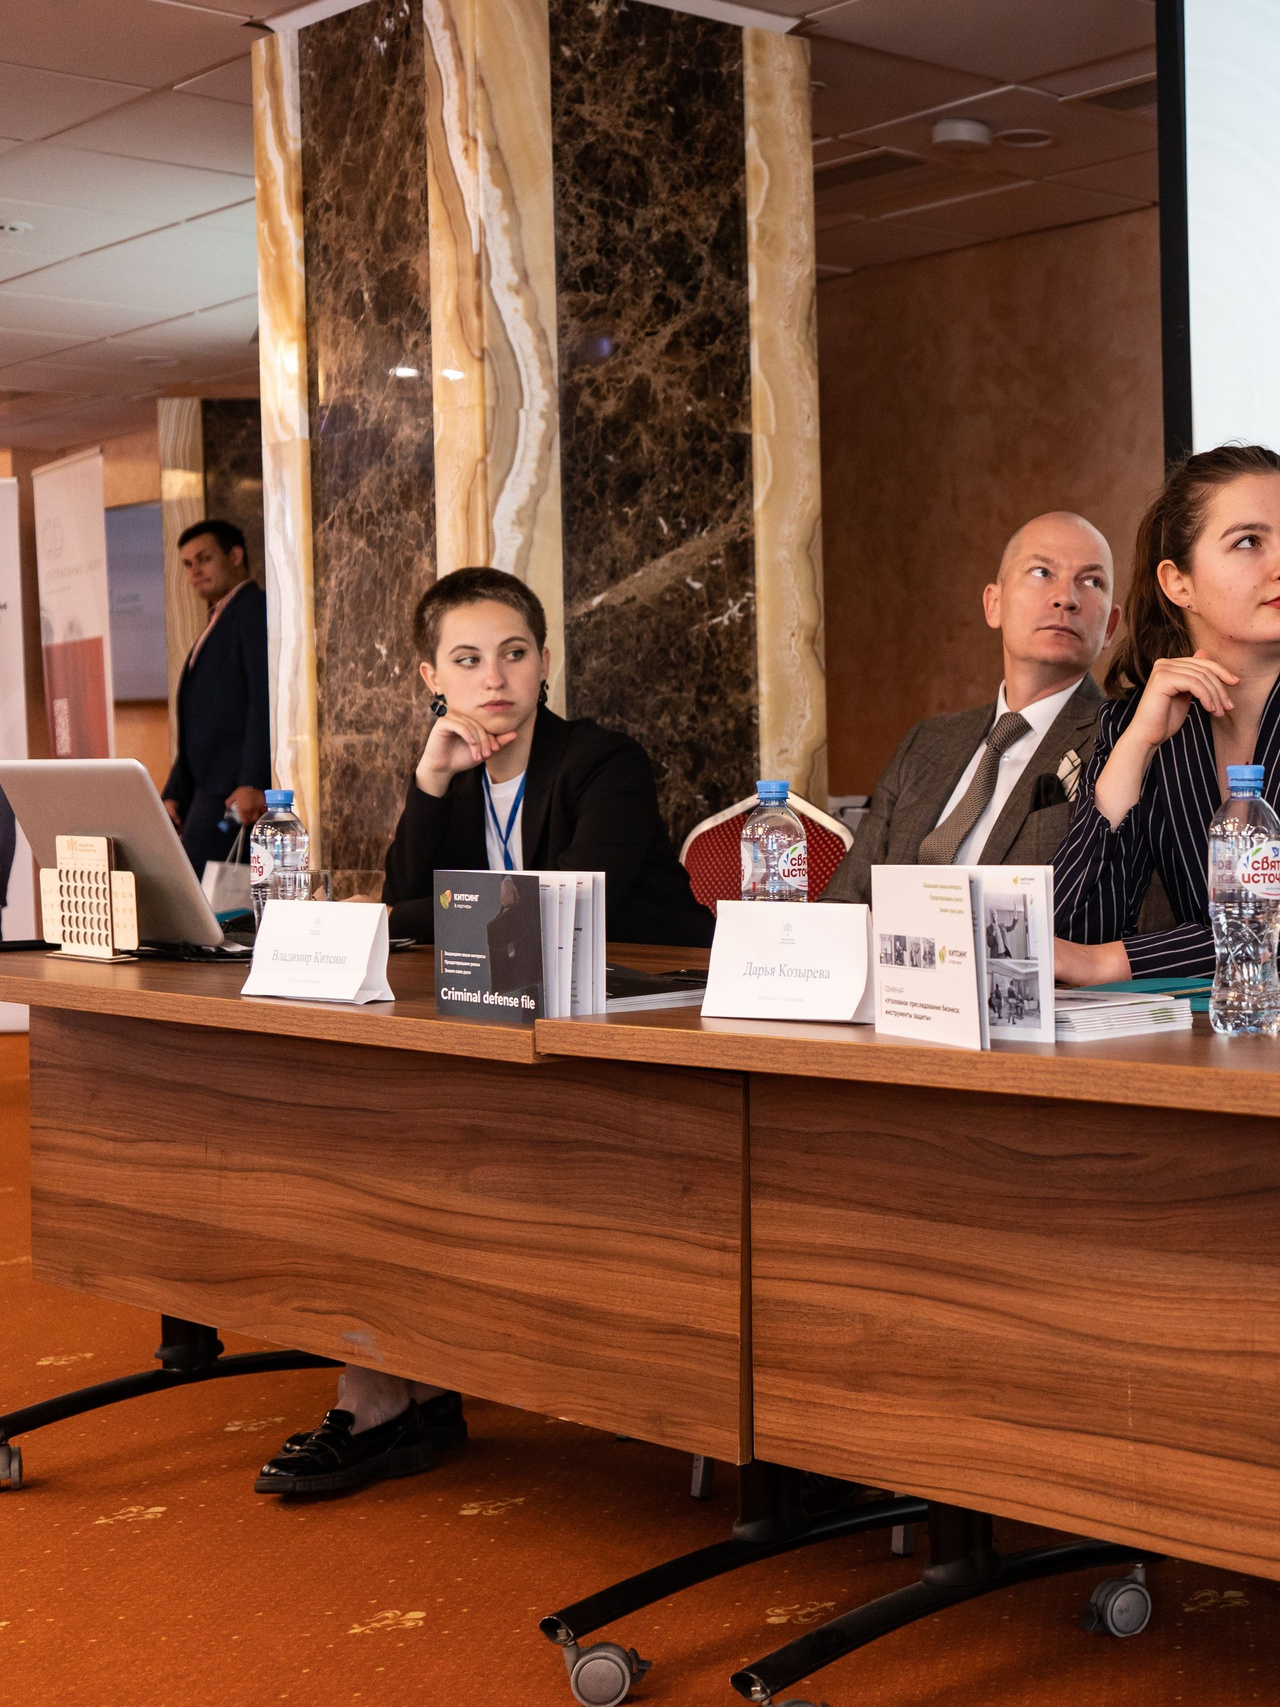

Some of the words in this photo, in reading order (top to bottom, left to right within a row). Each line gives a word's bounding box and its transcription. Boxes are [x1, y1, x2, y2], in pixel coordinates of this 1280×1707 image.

[272, 949, 312, 966] Владимир
[313, 951, 348, 965] Китсинг
[743, 961, 775, 979] Дарья
[778, 963, 831, 982] Козырева
[441, 987, 481, 1003] Criminal
[483, 991, 519, 1007] defense
[521, 995, 535, 1009] file
